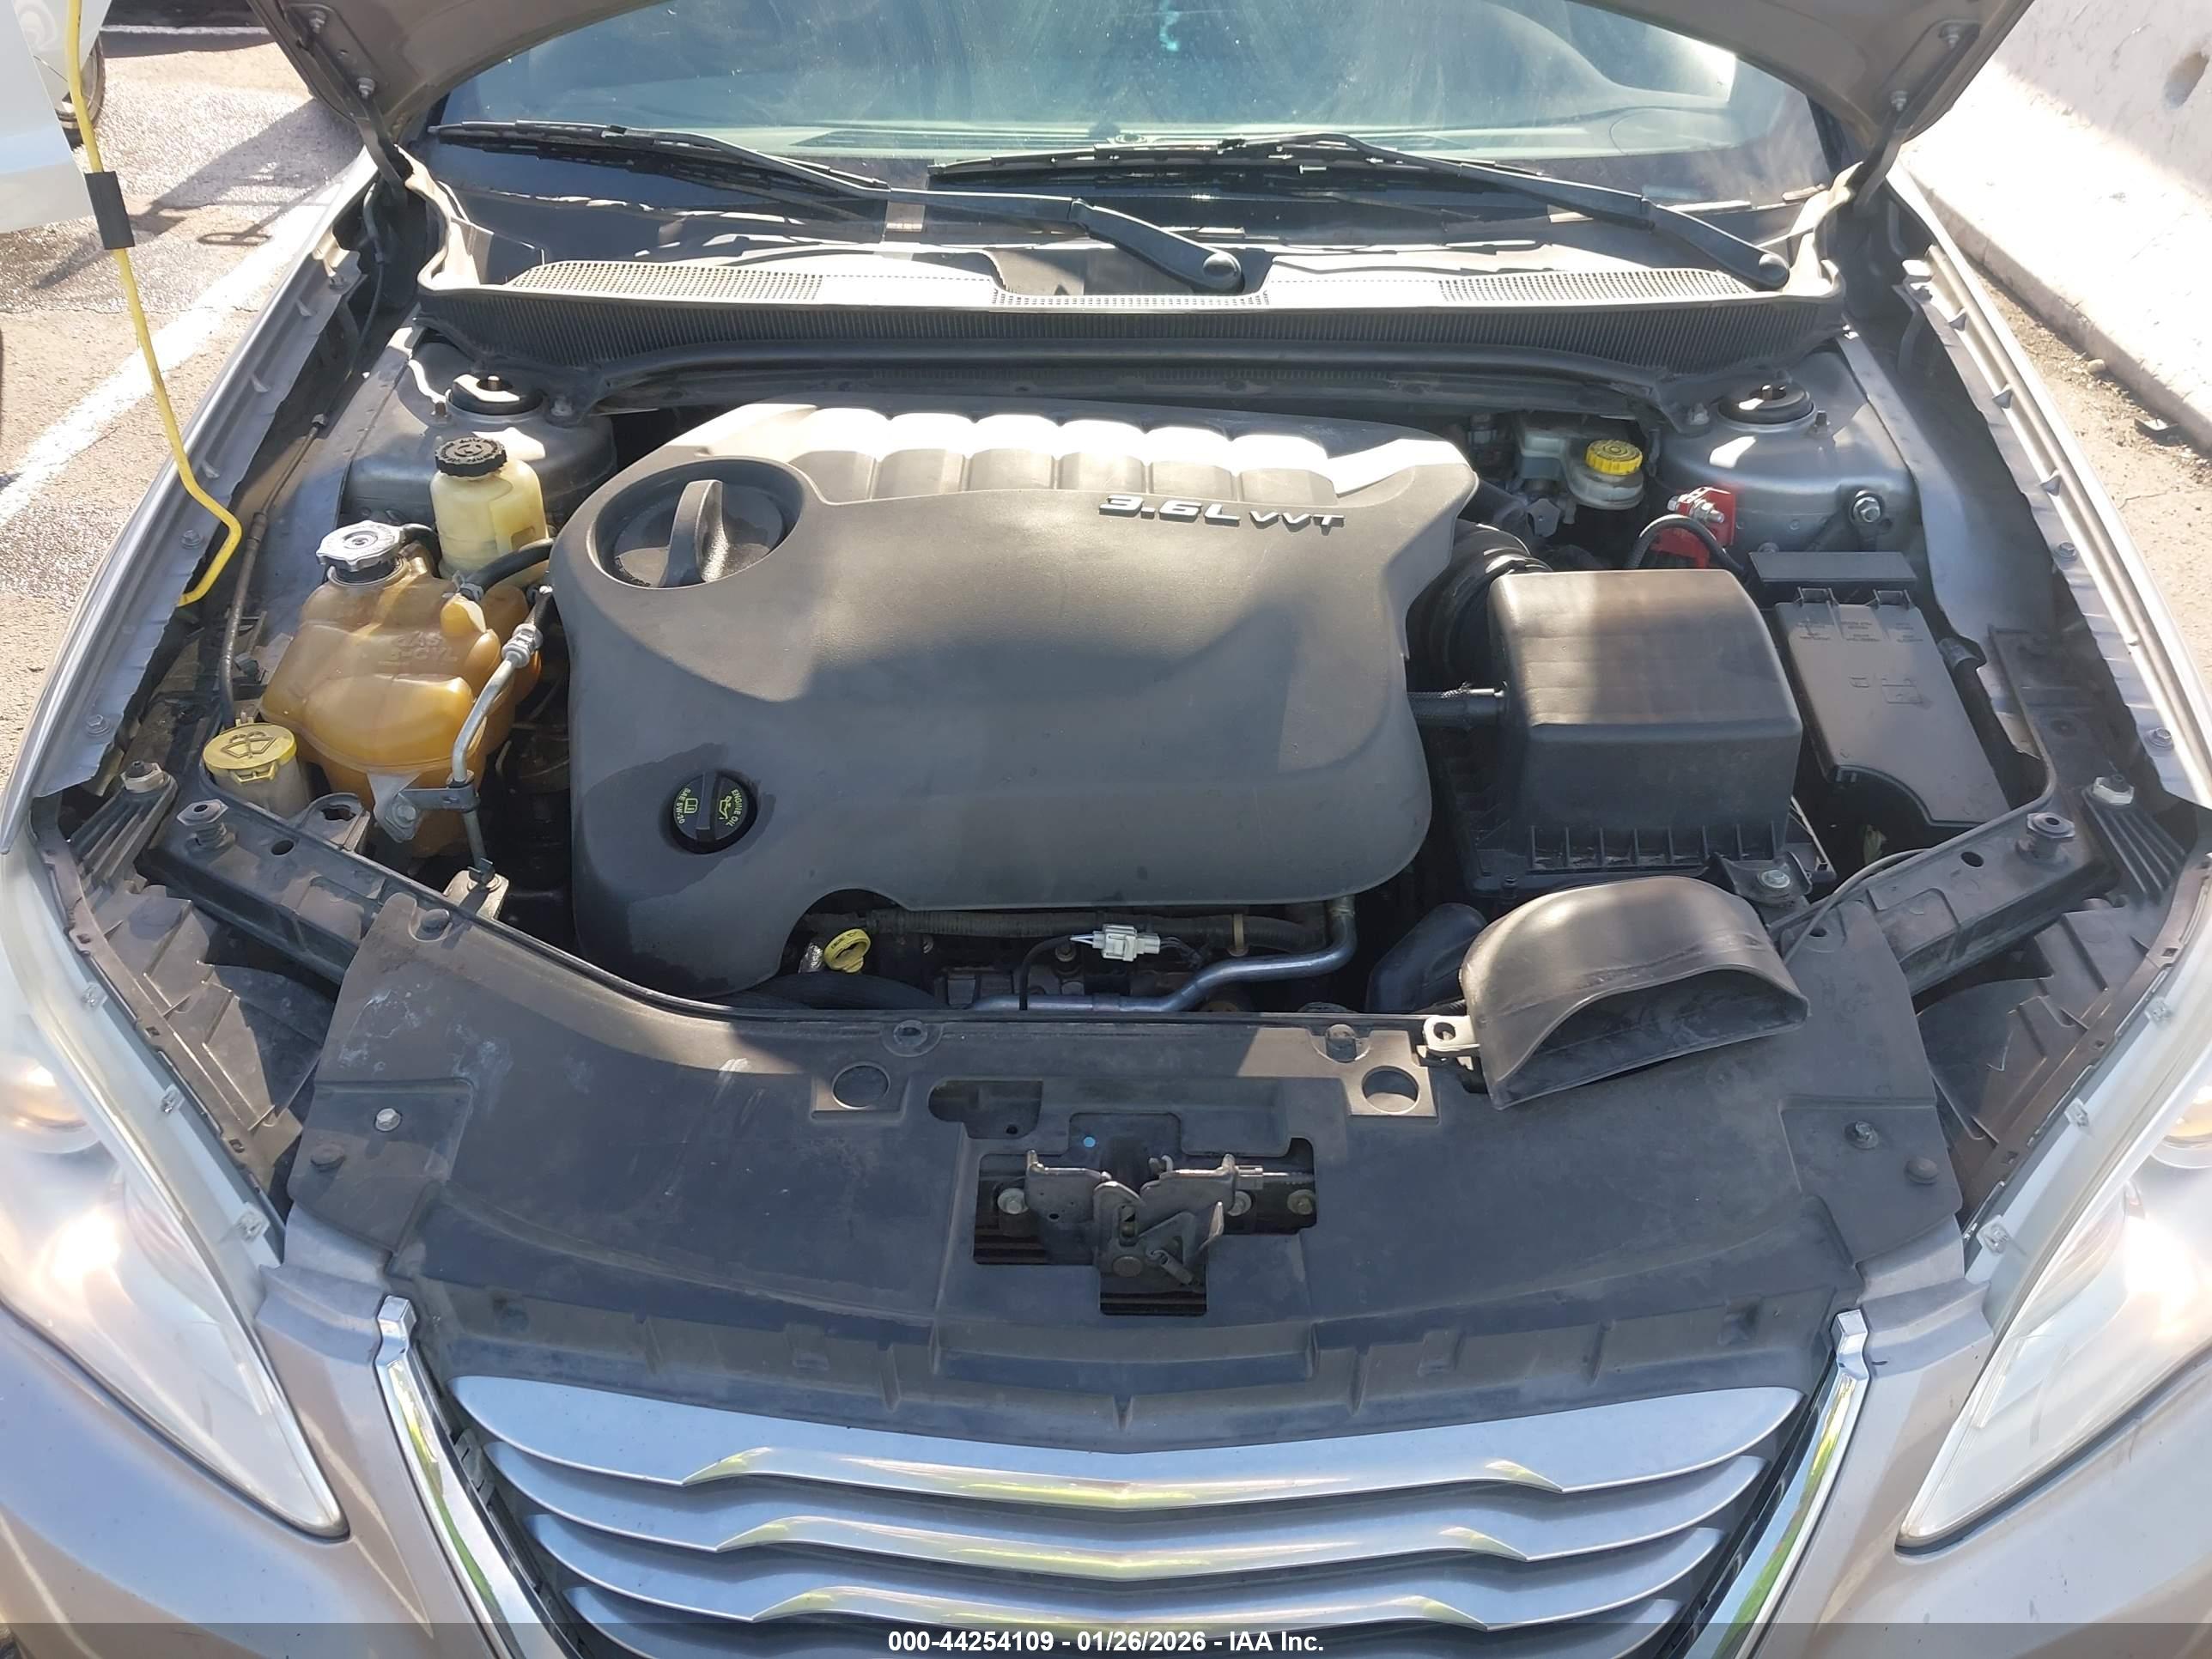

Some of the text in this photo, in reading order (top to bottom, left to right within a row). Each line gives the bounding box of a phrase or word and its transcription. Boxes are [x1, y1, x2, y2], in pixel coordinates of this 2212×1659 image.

[1098, 494, 1346, 536] 3.6L VVT
[678, 787, 691, 801] SAE
[725, 788, 743, 827] ENGINE OIL
